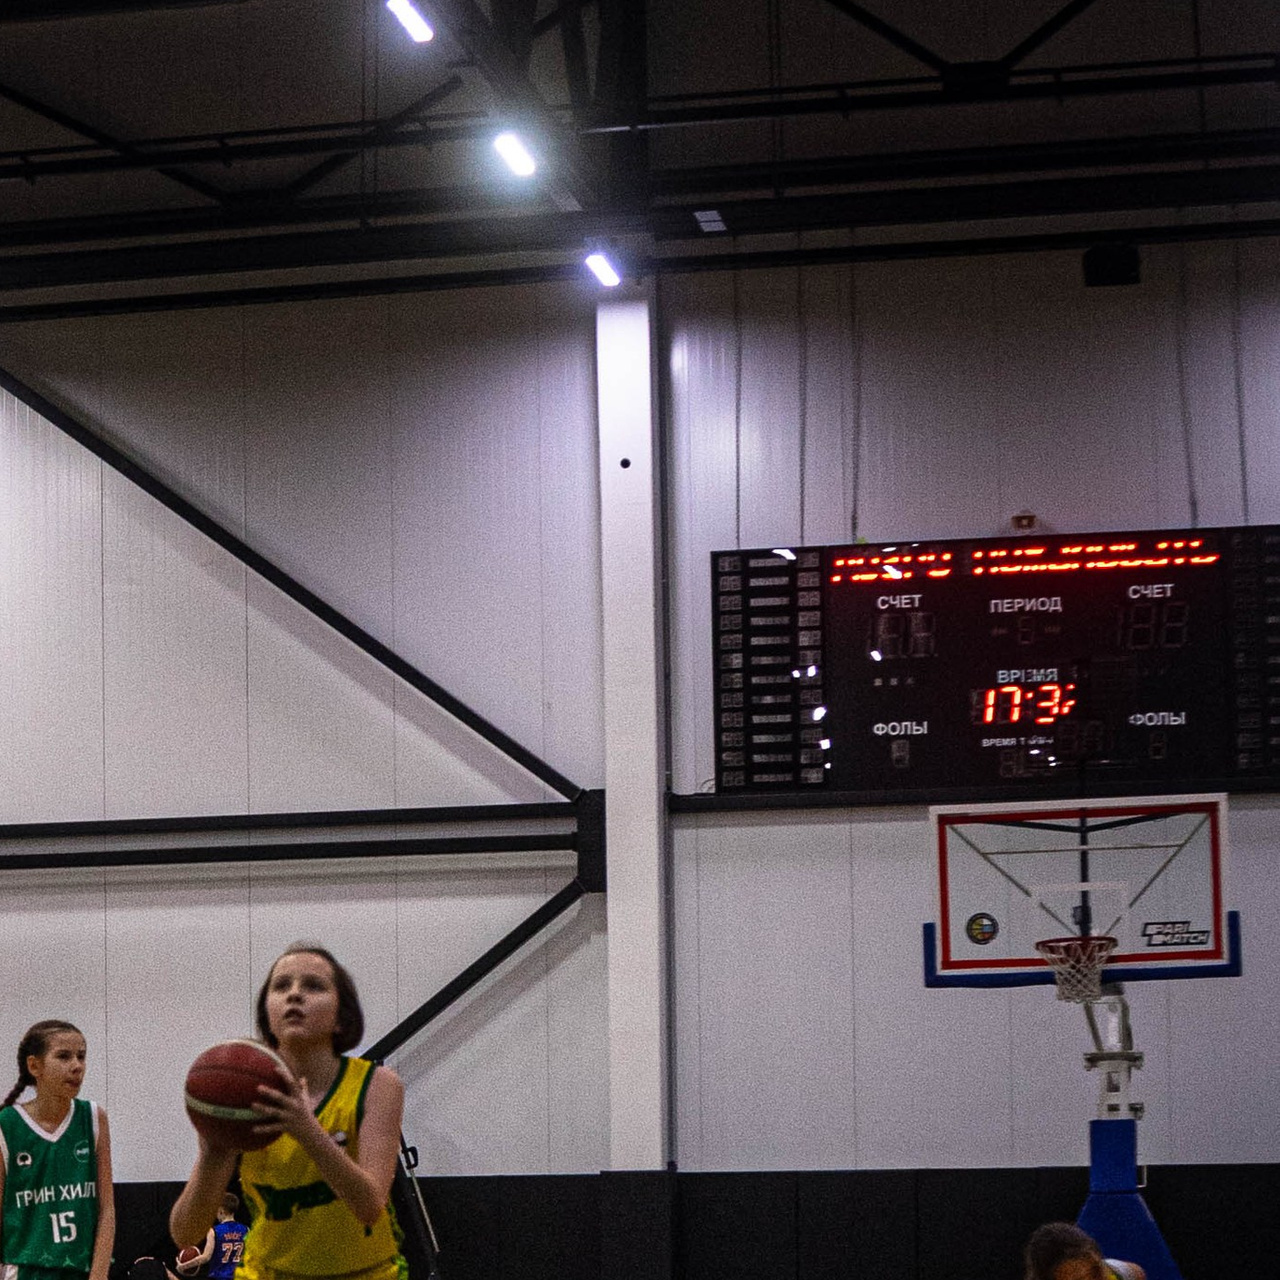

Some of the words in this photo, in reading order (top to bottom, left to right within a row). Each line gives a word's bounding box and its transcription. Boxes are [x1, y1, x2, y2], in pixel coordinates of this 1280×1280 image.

[1128, 584, 1174, 600] СЧЕТ
[877, 594, 922, 610] СЧЕТ
[989, 596, 1063, 614] ПЕРИОД
[1128, 711, 1187, 726] ФОЛЫ
[872, 721, 929, 736] ФОЛЫ
[15, 1185, 56, 1209] ГРИН
[49, 1210, 78, 1244] 15
[221, 1241, 244, 1264] 77
